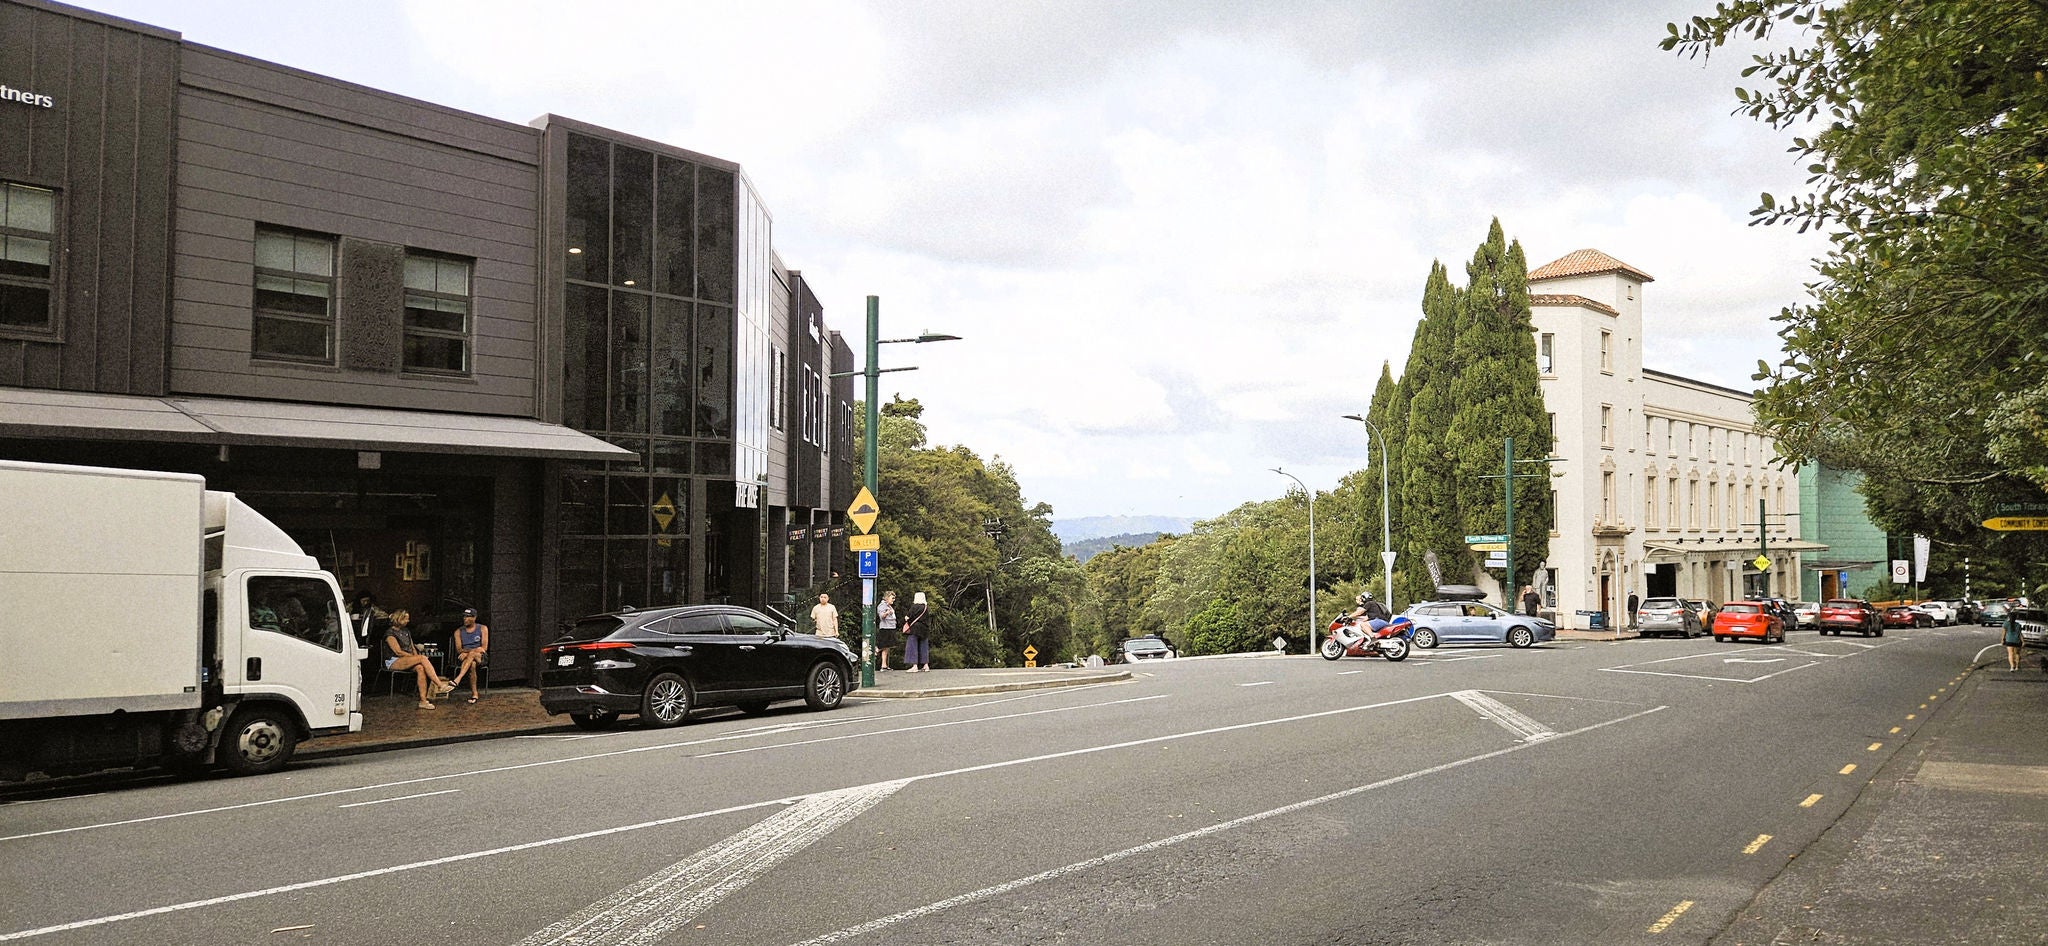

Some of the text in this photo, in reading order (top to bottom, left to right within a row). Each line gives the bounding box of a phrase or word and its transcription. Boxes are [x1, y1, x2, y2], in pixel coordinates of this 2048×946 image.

[0, 85, 53, 108] tners
[2000, 502, 2022, 512] South
[2000, 519, 2031, 528] COMMUNITY
[334, 693, 346, 703] 250
